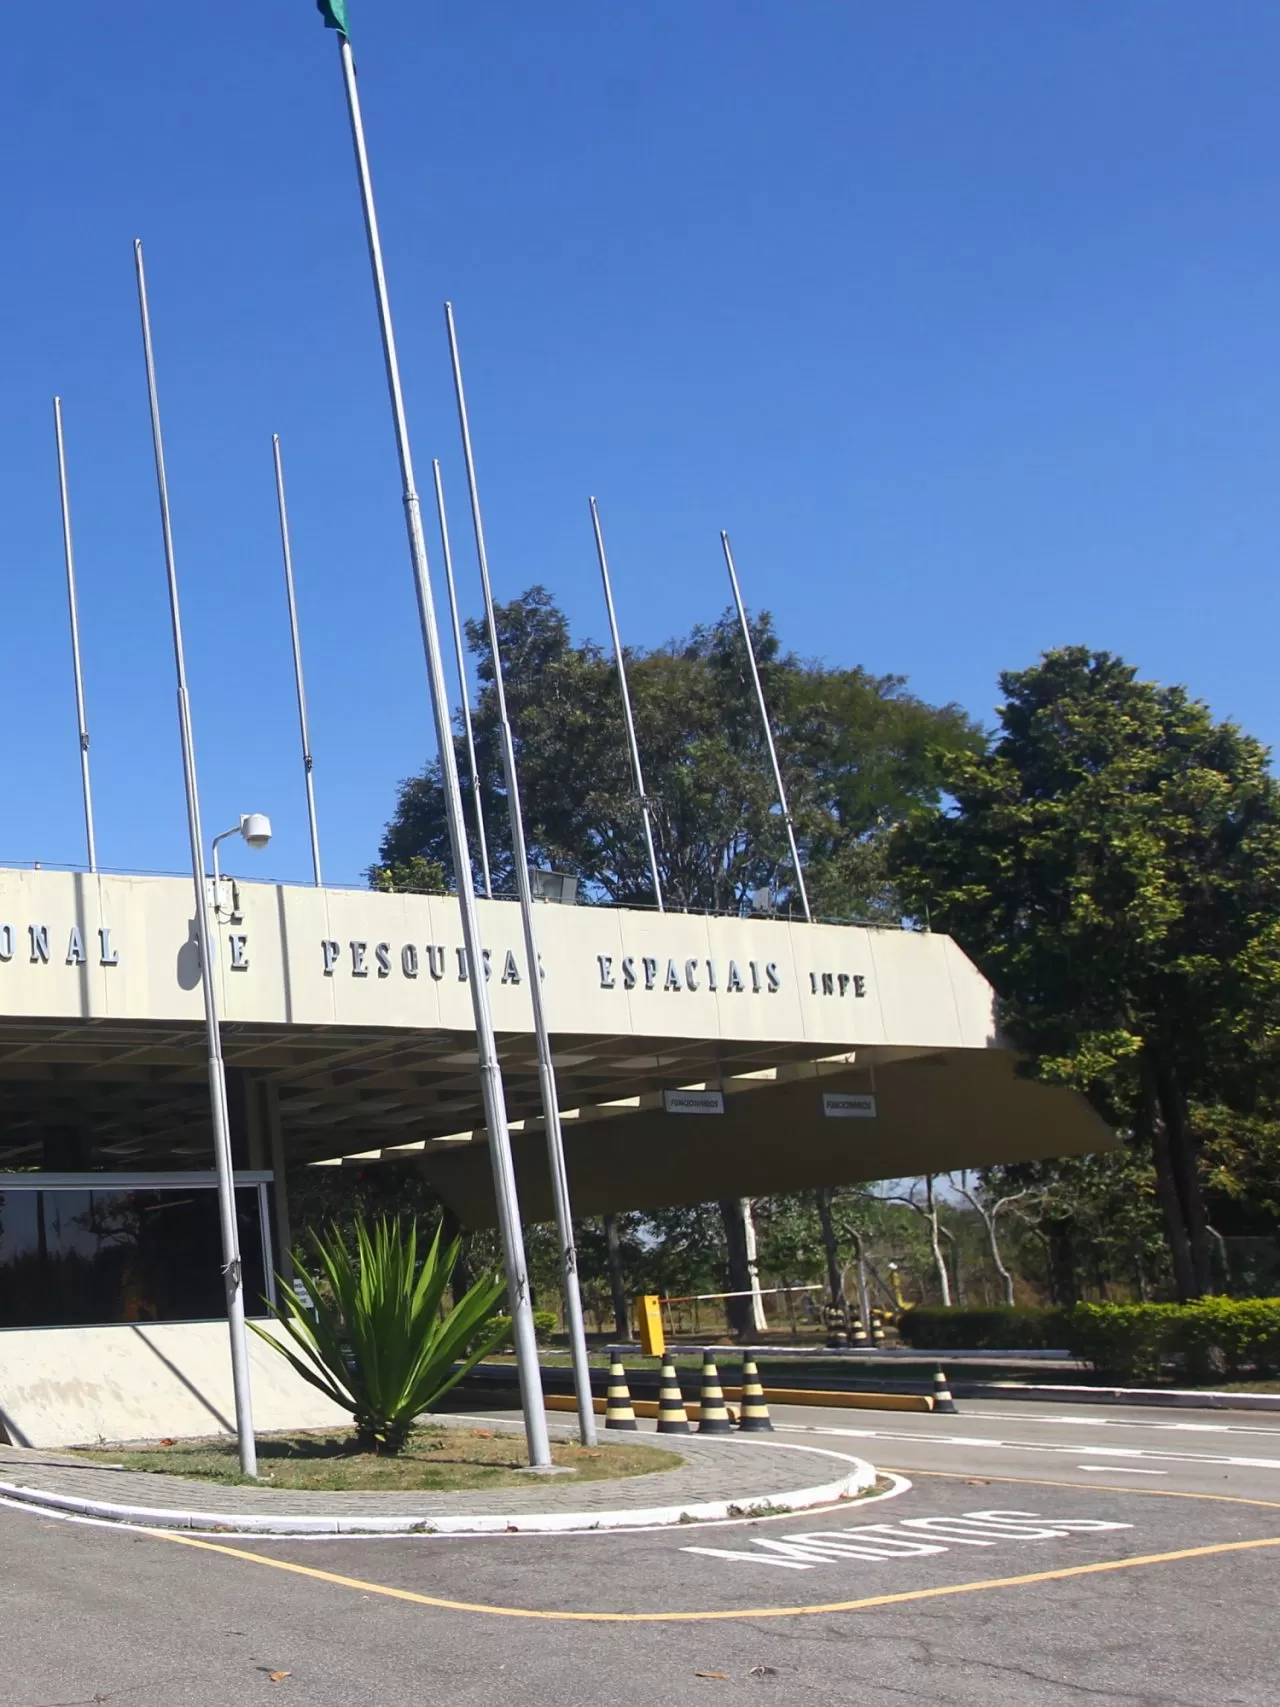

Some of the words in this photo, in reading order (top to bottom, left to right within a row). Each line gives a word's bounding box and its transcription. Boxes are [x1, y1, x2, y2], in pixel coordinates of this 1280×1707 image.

[598, 953, 780, 993] ESPACIAIS
[809, 971, 867, 998] INPE
[678, 1510, 1134, 1569] MOTOS
